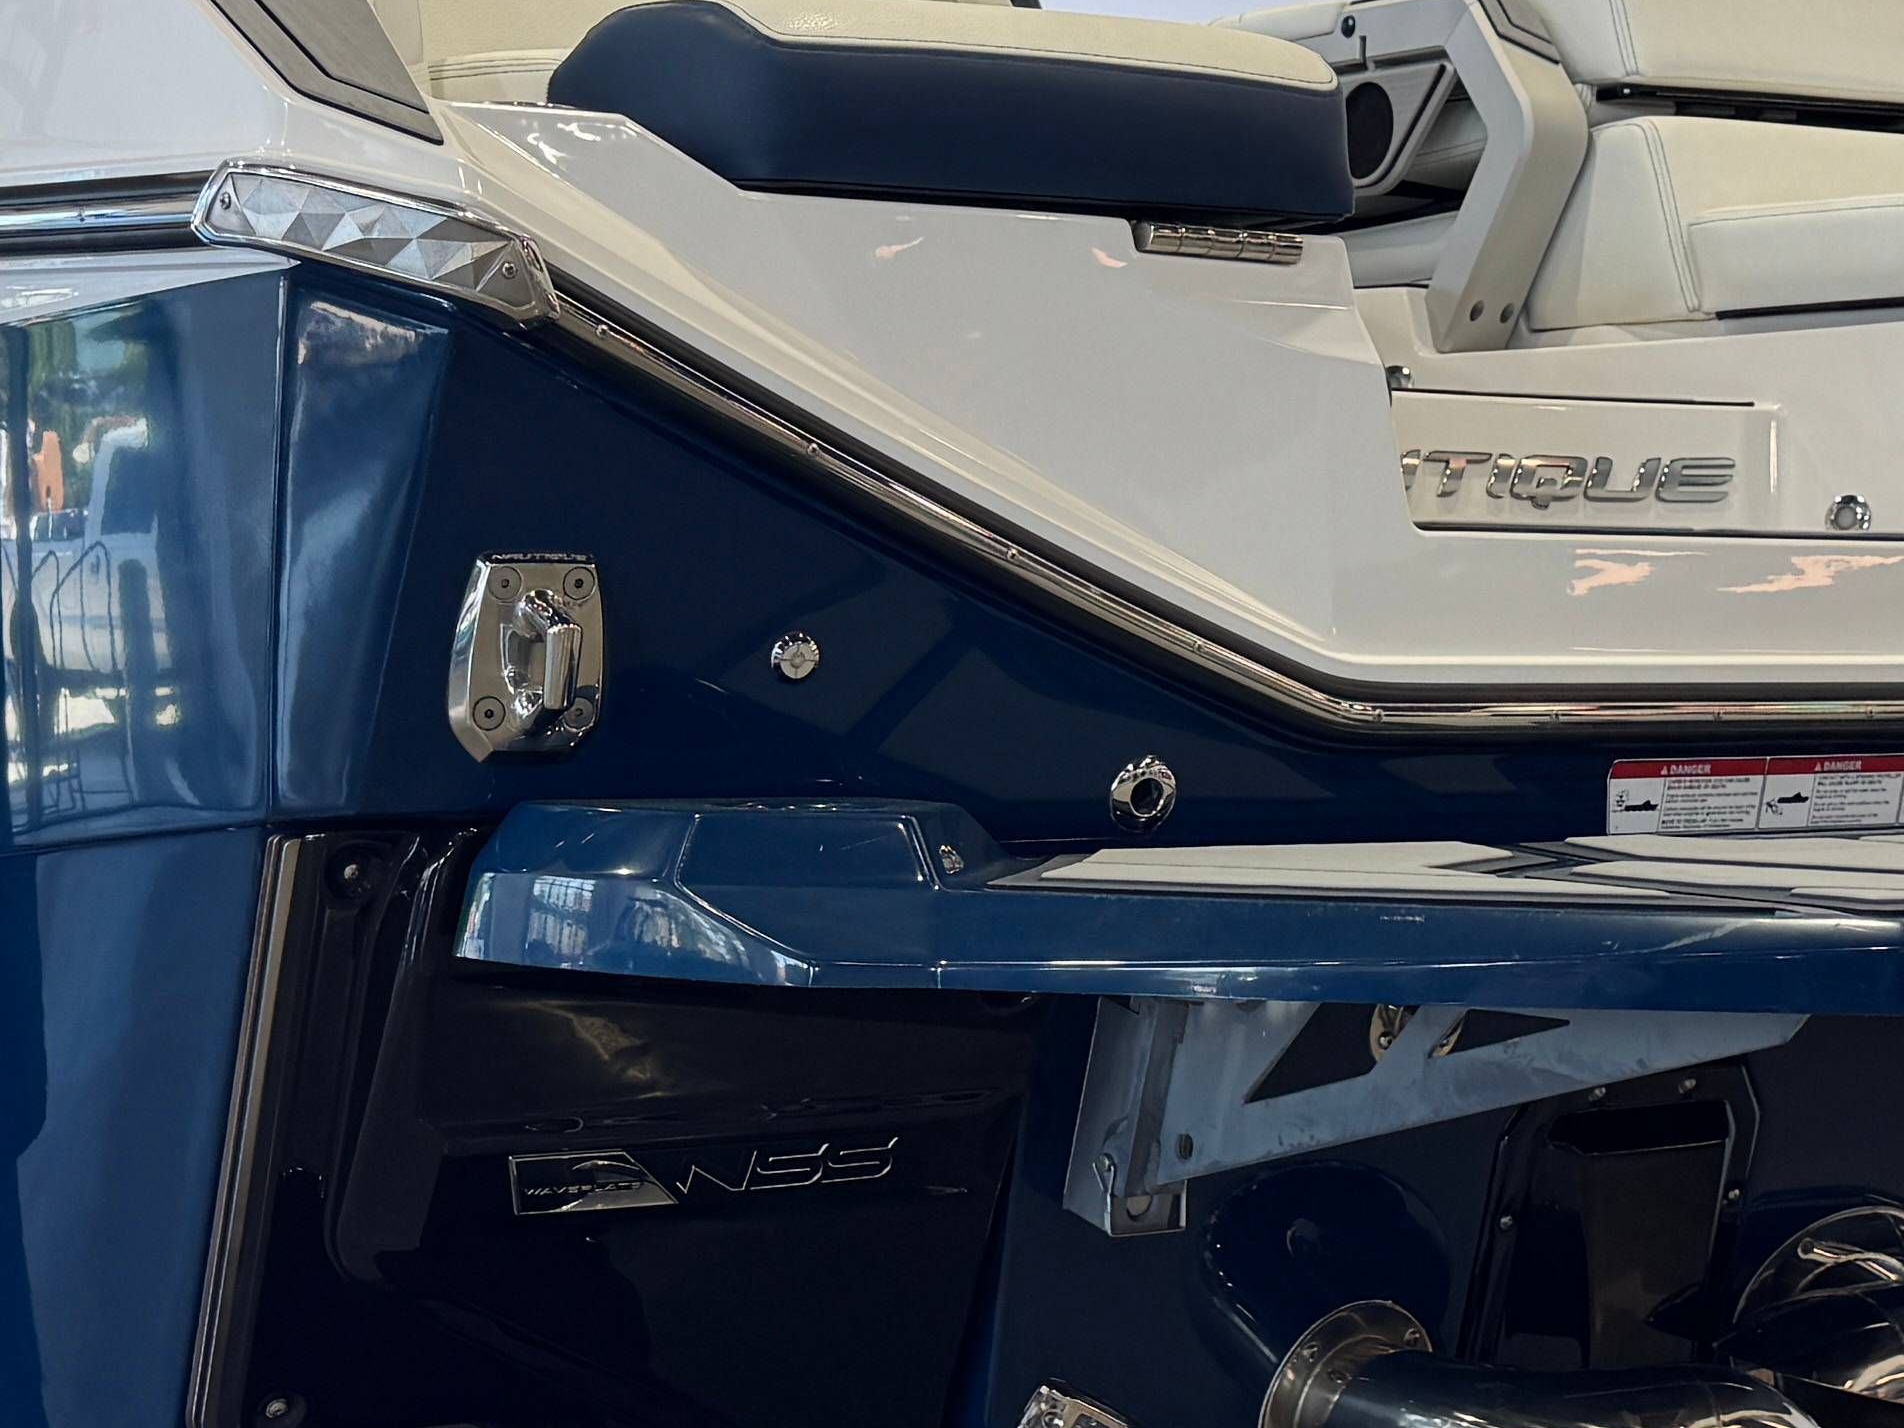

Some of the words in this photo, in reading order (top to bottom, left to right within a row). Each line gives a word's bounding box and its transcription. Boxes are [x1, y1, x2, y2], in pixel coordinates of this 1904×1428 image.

[1669, 763, 1712, 775] DANGER
[1823, 760, 1862, 772] DANGER
[676, 1136, 899, 1194] NSS
